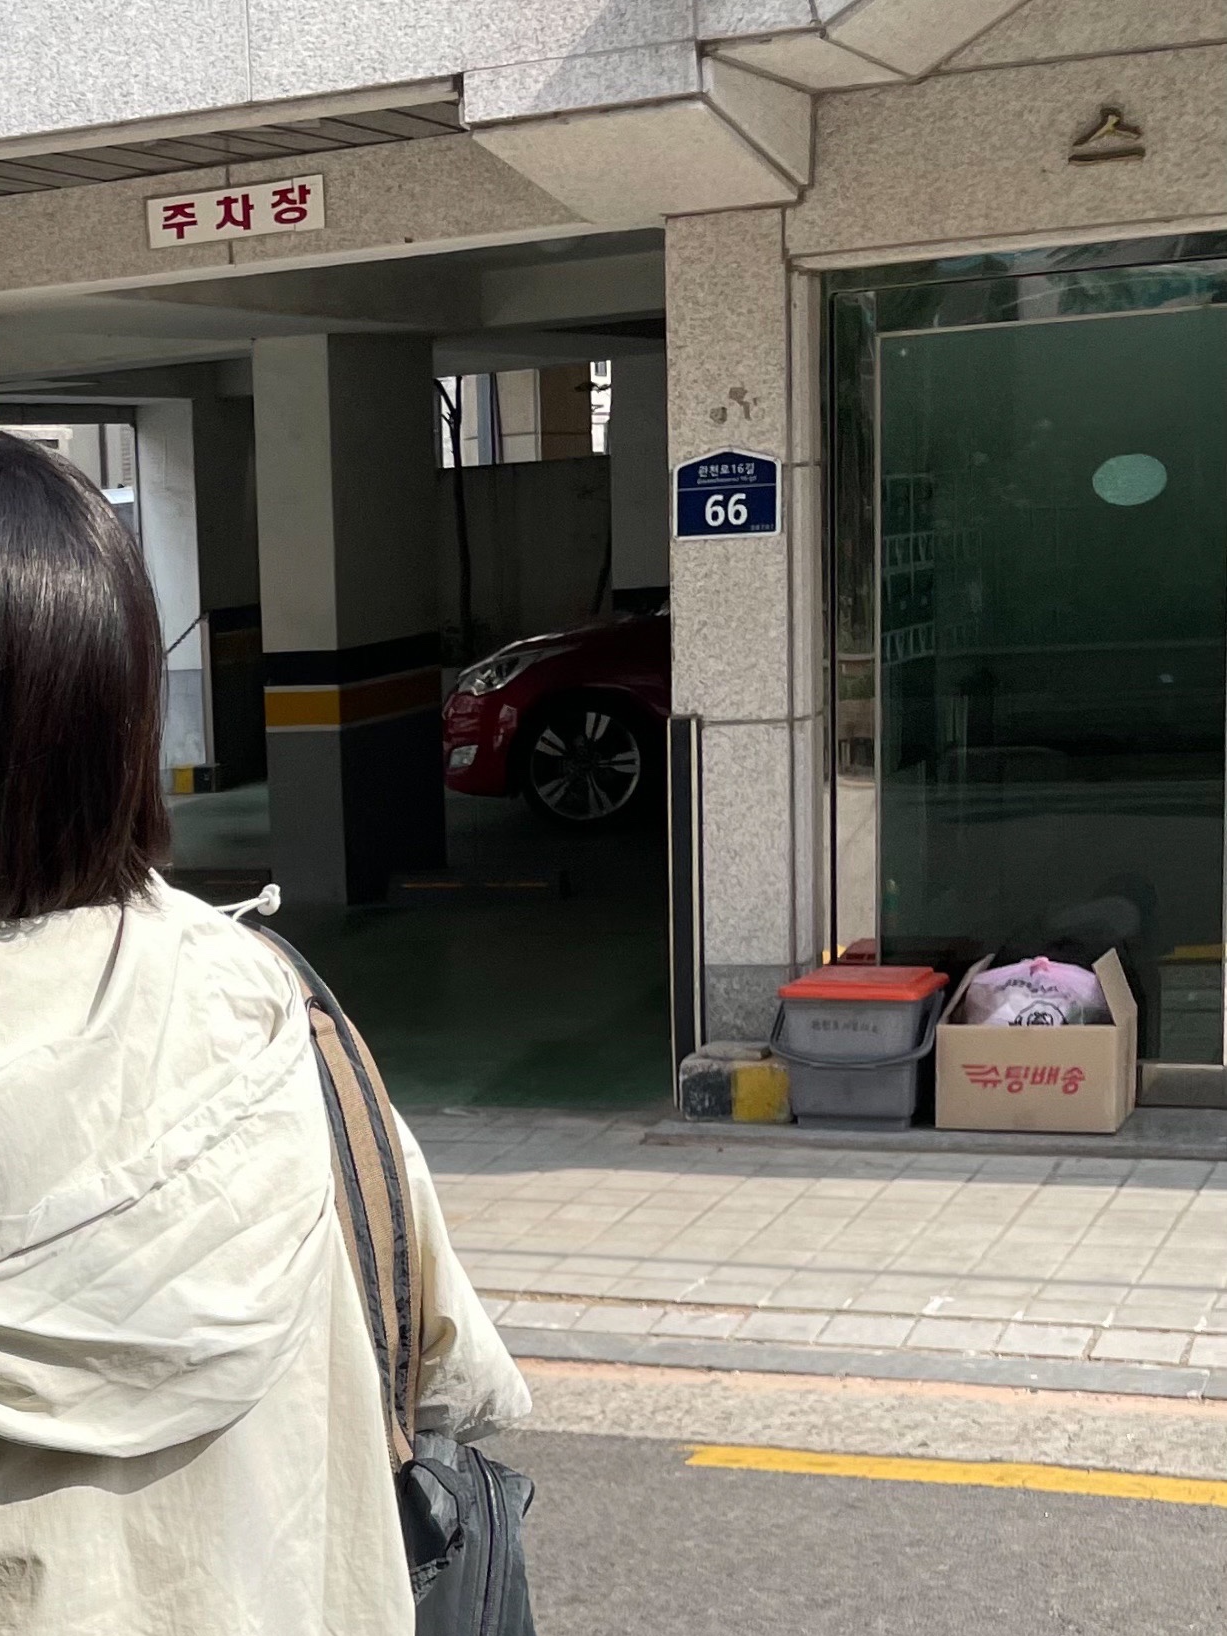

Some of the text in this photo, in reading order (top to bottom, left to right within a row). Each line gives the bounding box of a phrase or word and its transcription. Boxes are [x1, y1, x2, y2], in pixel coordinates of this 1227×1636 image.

[161, 184, 311, 240] 주차장
[704, 493, 748, 527] 66
[962, 1064, 1086, 1095] 슈팅배송
